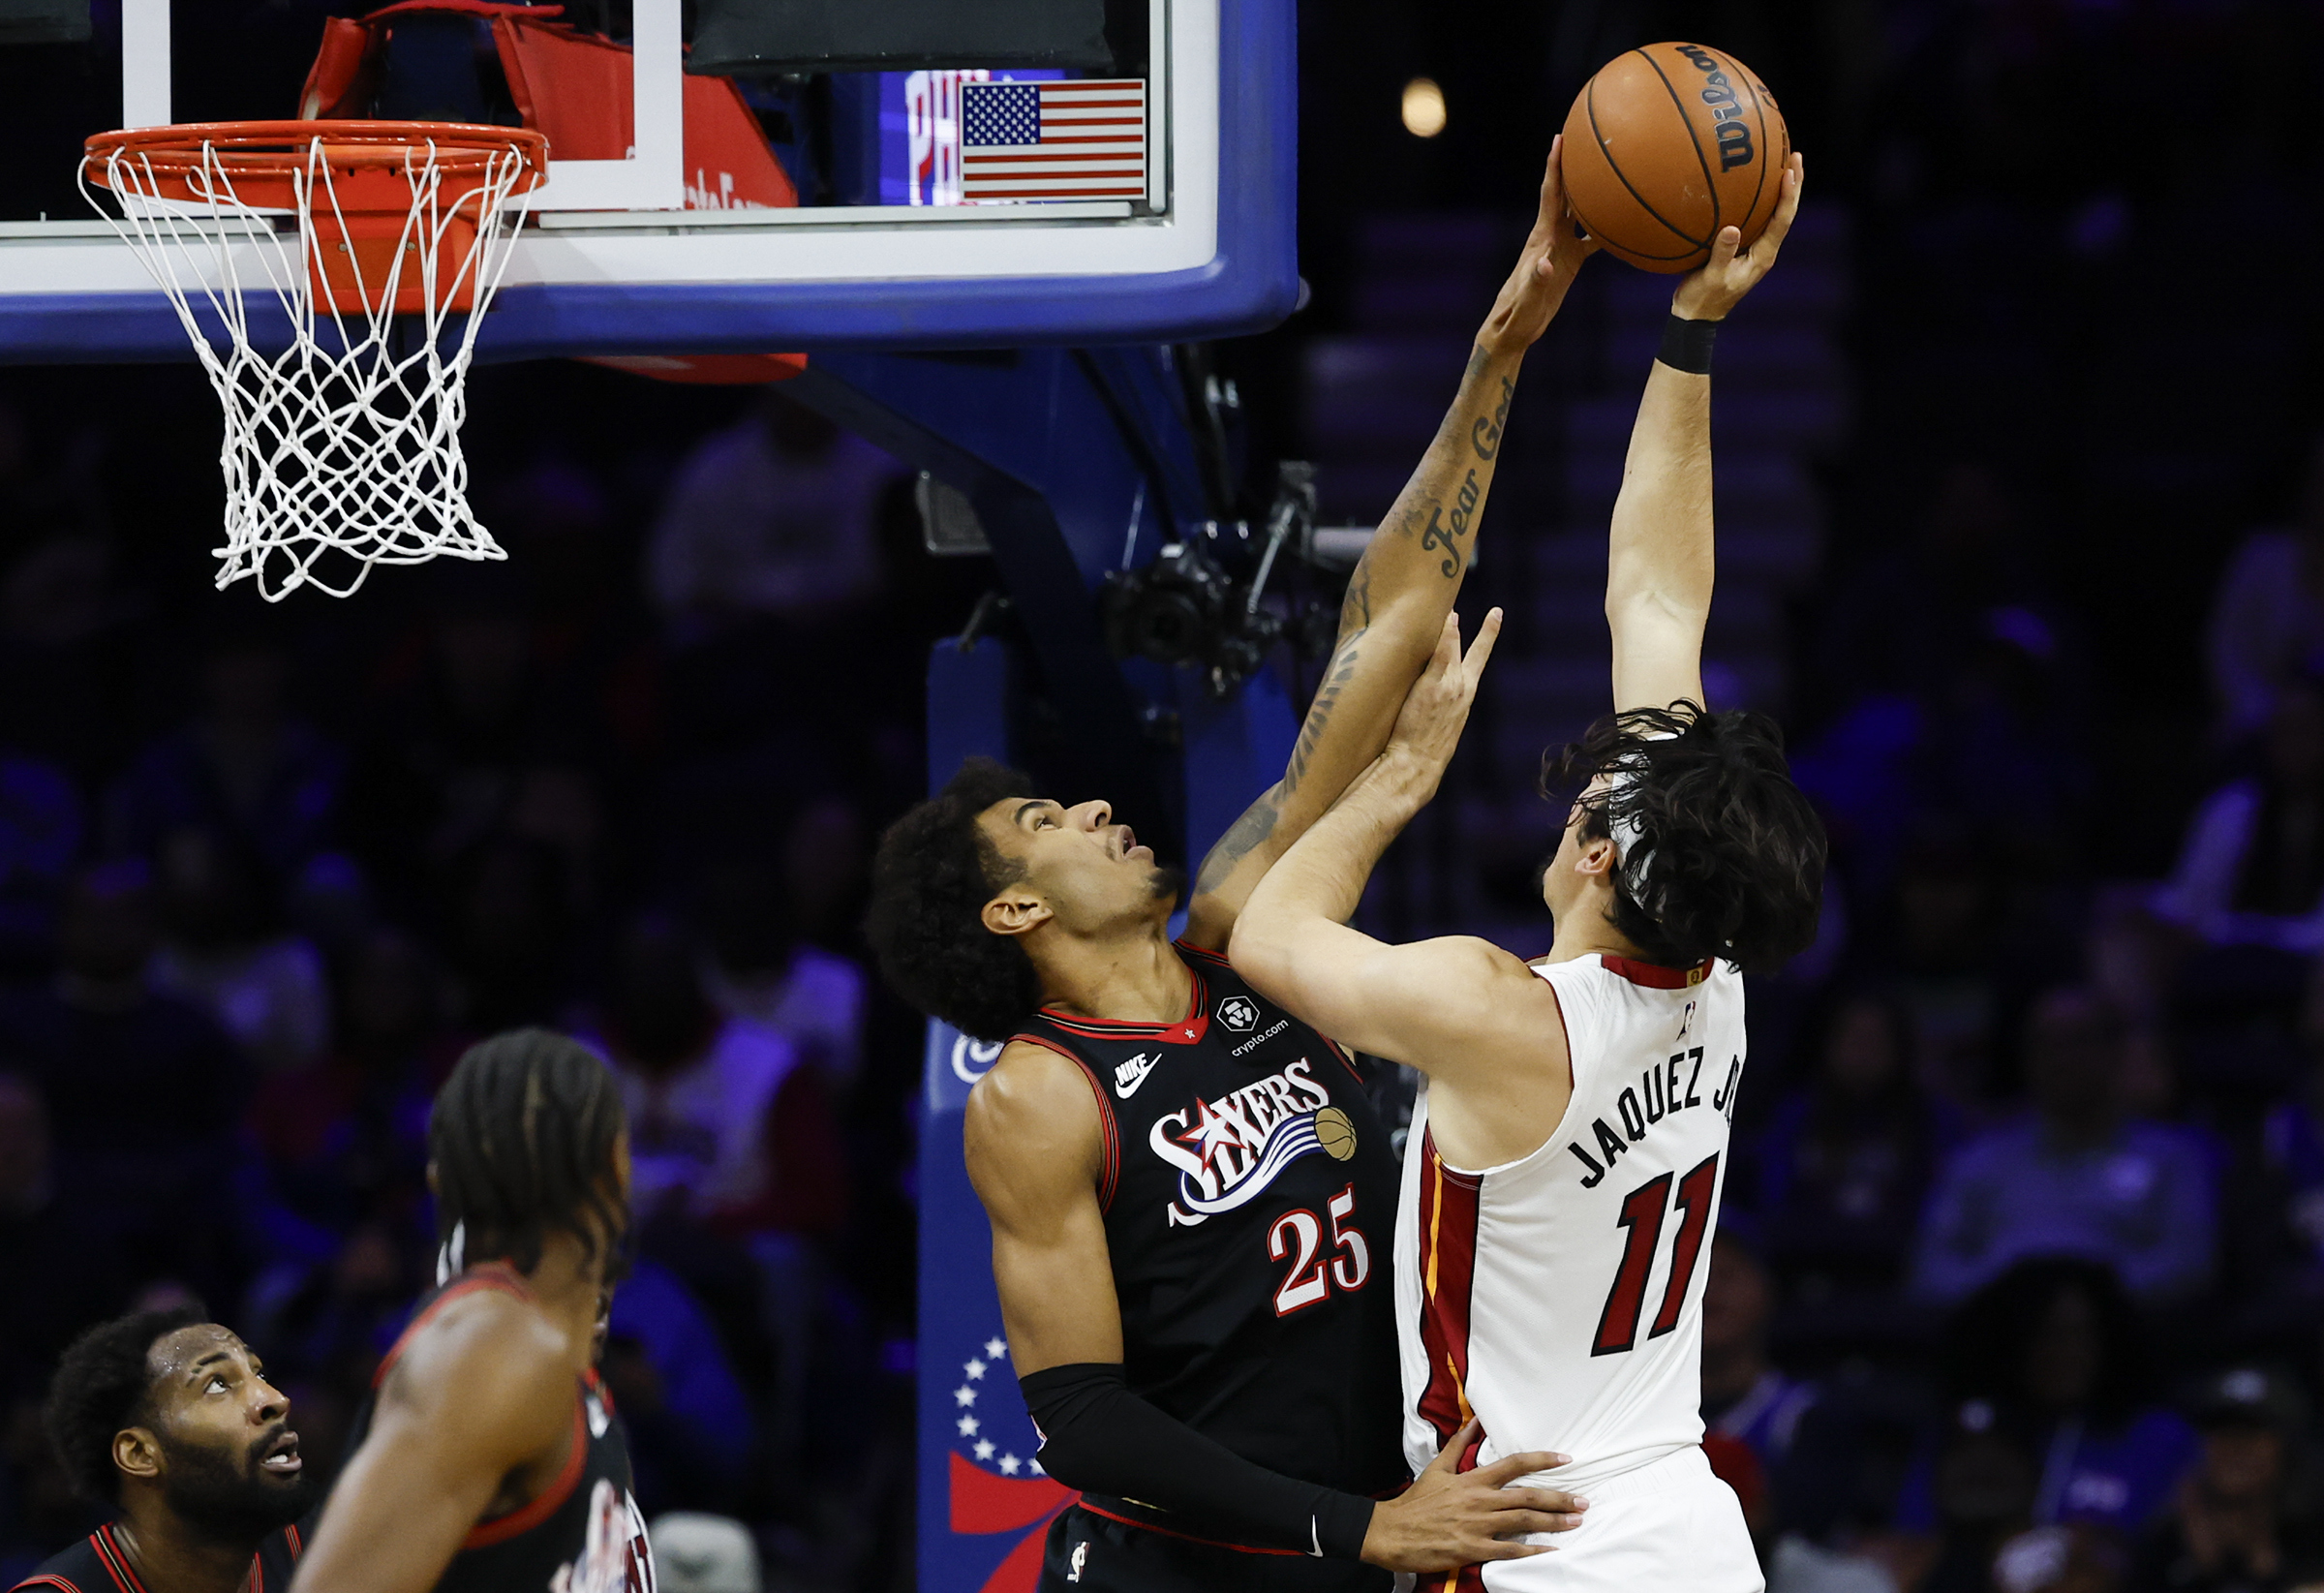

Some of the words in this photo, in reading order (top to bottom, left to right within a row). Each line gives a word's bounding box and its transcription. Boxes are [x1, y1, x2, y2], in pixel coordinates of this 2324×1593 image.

[1422, 469, 1481, 578] Fear
[1115, 1053, 1147, 1086] NIKE
[1232, 1018, 1289, 1057] crypto.com
[1567, 1046, 1703, 1188] JAQUEZ
[1267, 1181, 1372, 1318] 25
[1590, 1149, 1721, 1357] 11
